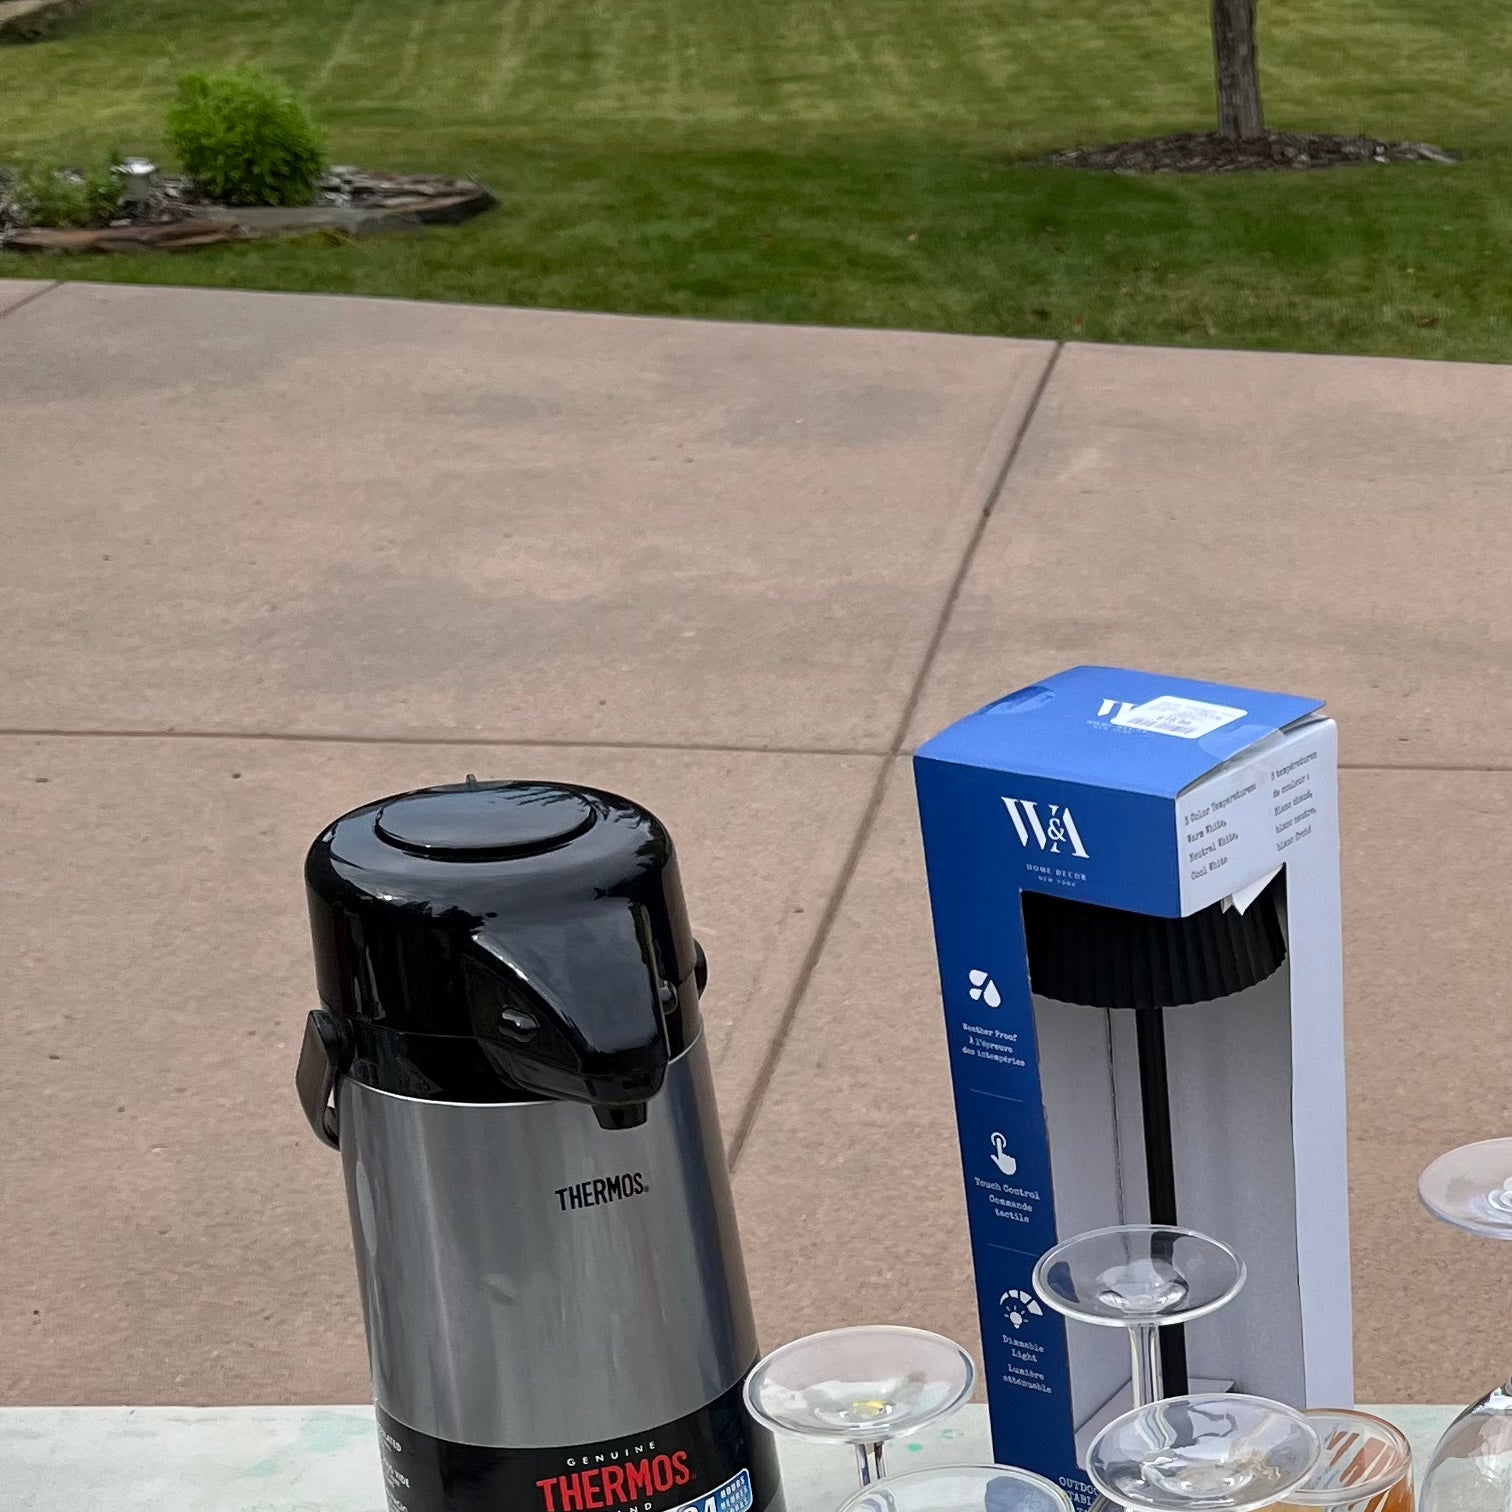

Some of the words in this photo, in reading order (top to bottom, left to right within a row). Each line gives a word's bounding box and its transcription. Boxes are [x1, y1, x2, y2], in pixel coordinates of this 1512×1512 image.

[1190, 806, 1210, 824] Color
[1001, 796, 1090, 859] W&A
[1189, 843, 1217, 862] Neutral
[1026, 863, 1051, 875] HOME
[1191, 866, 1208, 880] Cool
[1209, 856, 1228, 871] White
[995, 1029, 1018, 1042] Proof
[554, 1172, 644, 1211] THERMOS
[973, 1176, 1002, 1191] Touch
[1003, 1184, 1041, 1200] Control
[994, 1207, 1030, 1223] tactile
[1002, 1334, 1045, 1353] Dimmable
[1011, 1348, 1038, 1363] Light
[566, 1440, 656, 1467] GENUINE
[535, 1450, 691, 1512] THERMOS
[720, 1475, 745, 1499] HOURS
